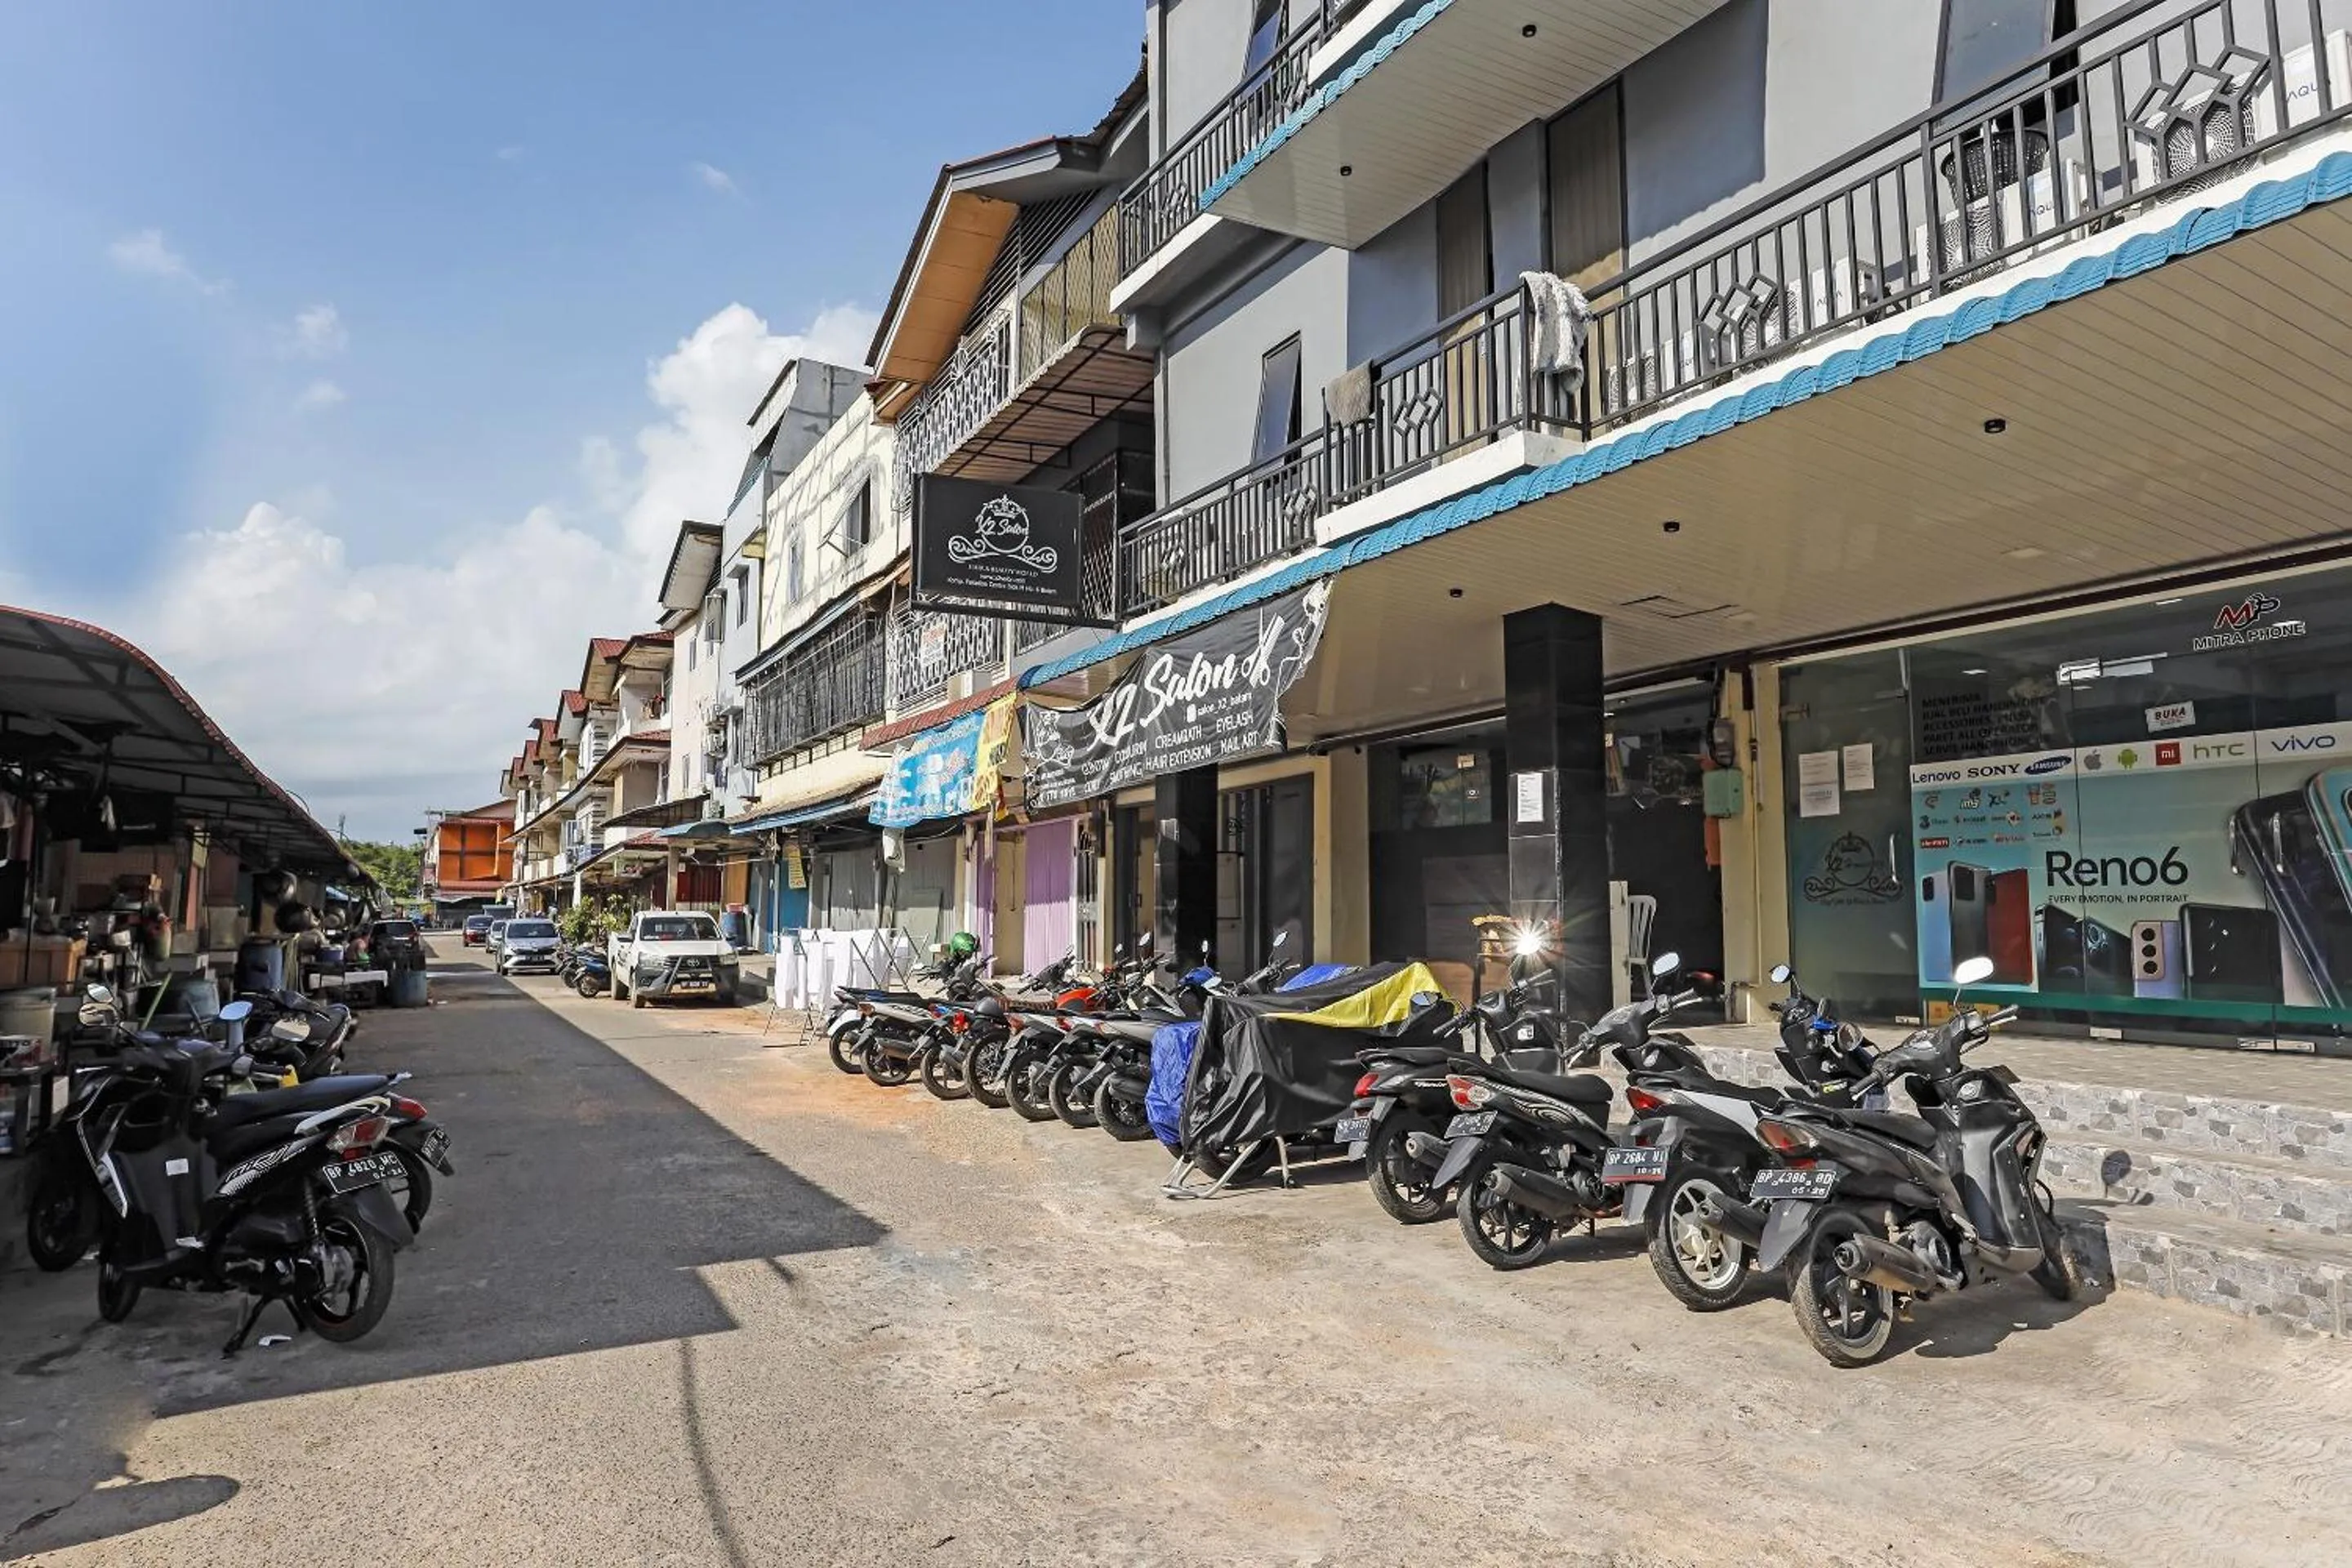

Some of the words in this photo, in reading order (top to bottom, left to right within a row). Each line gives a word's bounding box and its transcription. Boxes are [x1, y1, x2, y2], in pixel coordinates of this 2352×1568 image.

[997, 518, 1029, 537] Salon
[2193, 630, 2245, 652] MITRA
[2247, 621, 2306, 642] PHONE
[1140, 652, 1238, 727] Salon
[2155, 706, 2186, 720] BUKA
[1146, 754, 1168, 771] HAIR
[1169, 742, 1212, 767] EXTENSION
[1221, 736, 1241, 755] NAIL
[1241, 730, 1259, 750] ART
[1912, 771, 1961, 783] Lenovo
[1967, 764, 2020, 778] SONY
[2271, 735, 2336, 752] vivo
[2046, 846, 2189, 887] Reno6
[2048, 894, 2077, 904] EVERY
[2127, 894, 2139, 902] IN
[2140, 894, 2189, 903] PORTRAIT
[1757, 1172, 1773, 1183] BP
